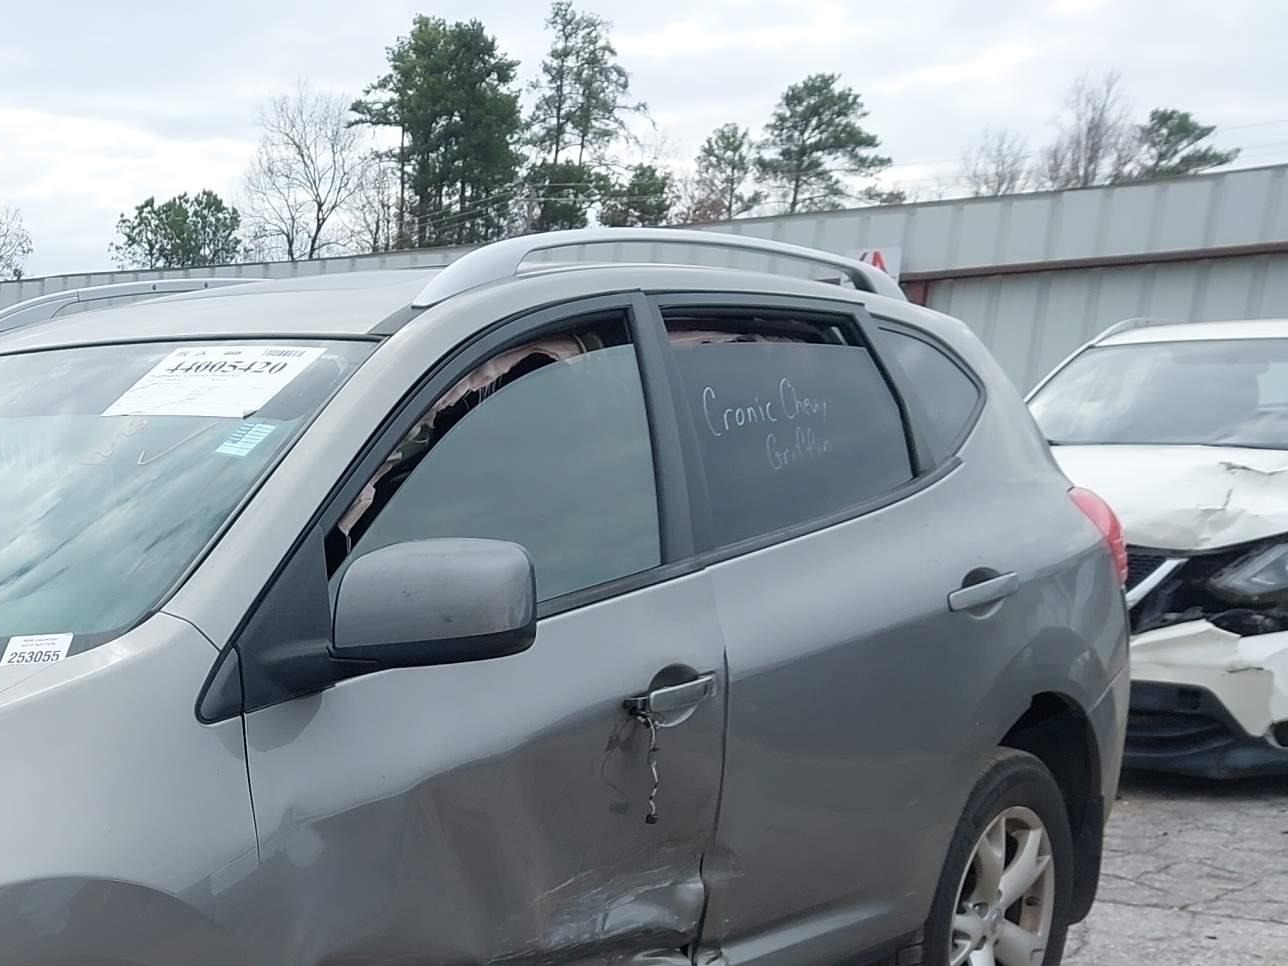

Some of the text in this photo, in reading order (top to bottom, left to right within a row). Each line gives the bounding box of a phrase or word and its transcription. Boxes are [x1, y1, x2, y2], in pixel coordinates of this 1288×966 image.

[165, 360, 288, 374] 44005420
[702, 386, 777, 437] Cronic
[7, 649, 61, 664] 253055
